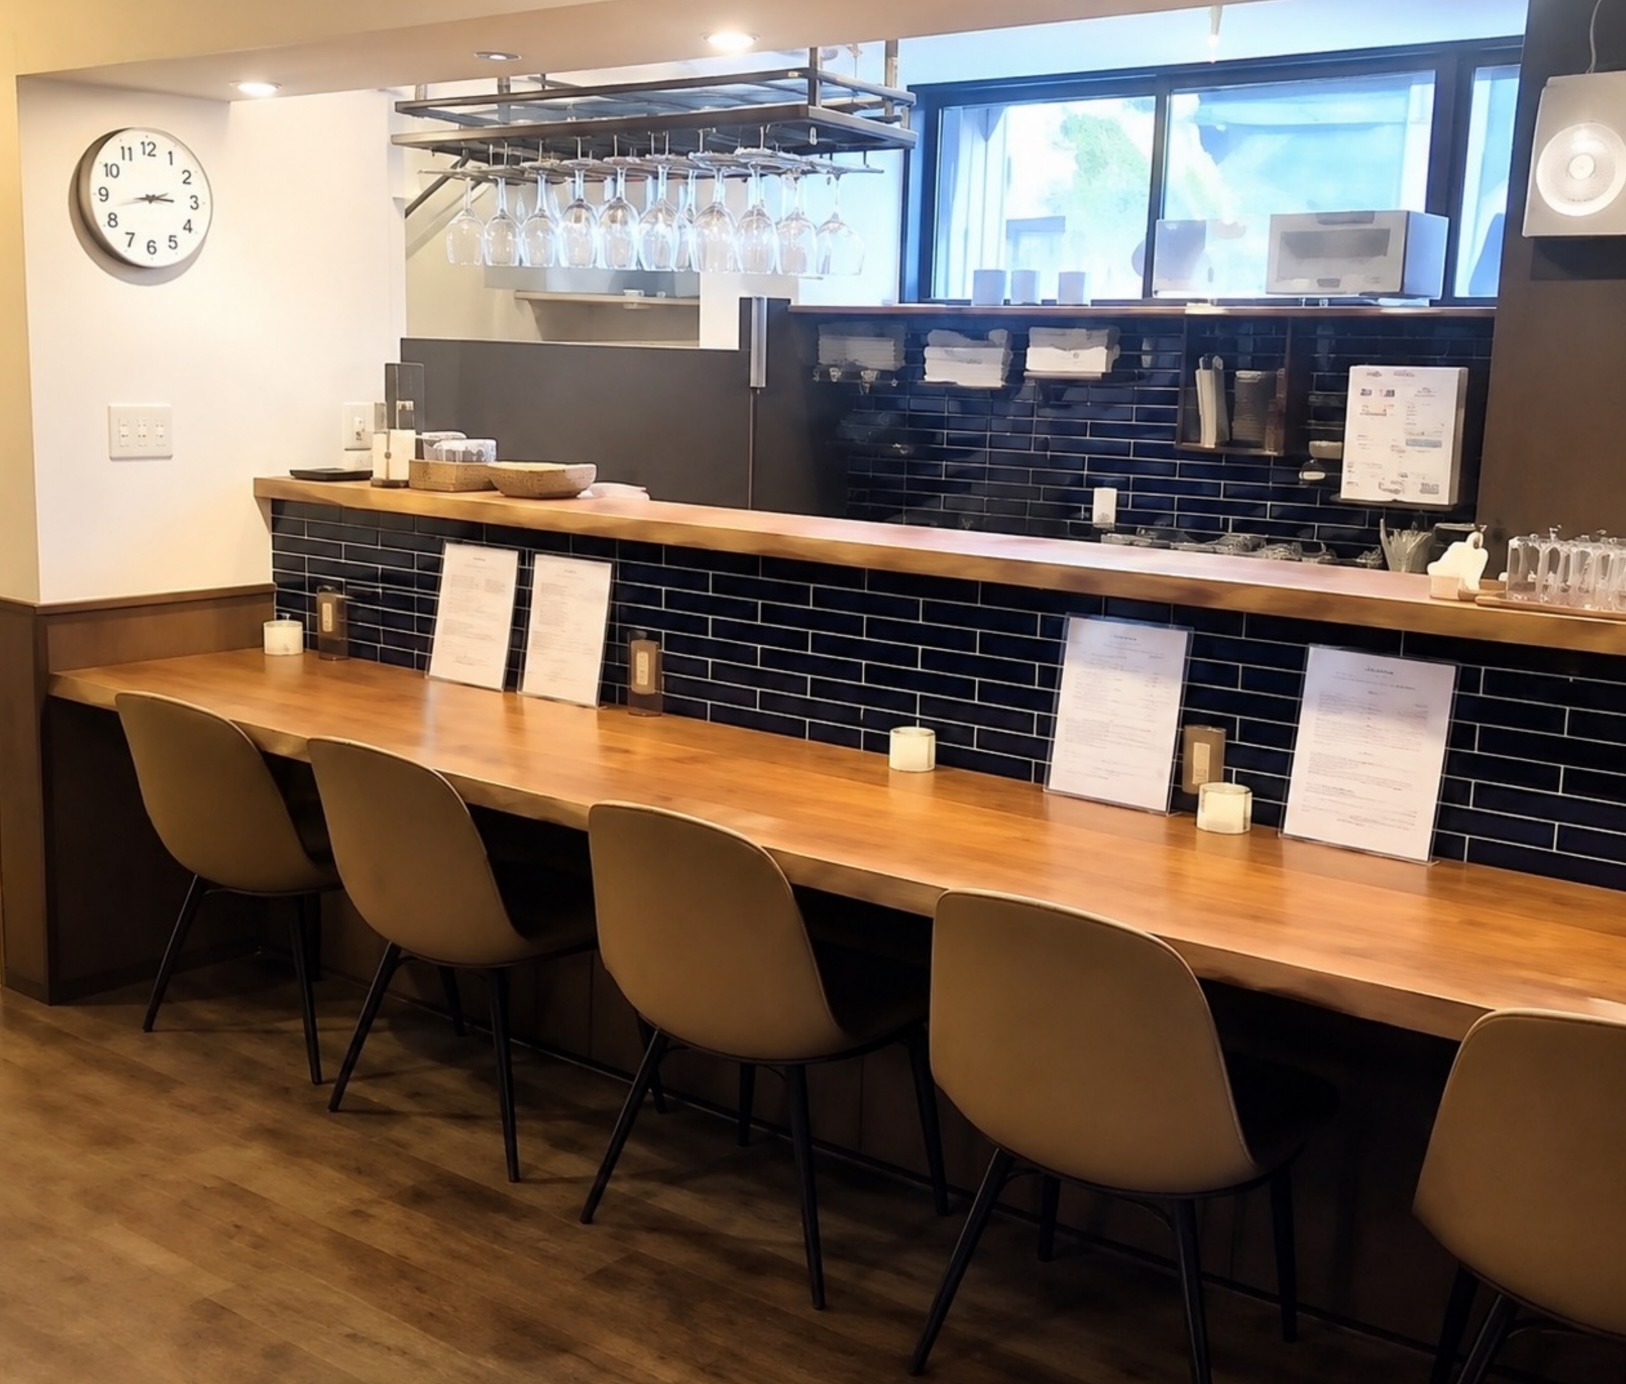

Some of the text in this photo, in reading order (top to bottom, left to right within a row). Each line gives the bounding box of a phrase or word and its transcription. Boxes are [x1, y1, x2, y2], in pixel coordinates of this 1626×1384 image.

[120, 145, 133, 161] 11
[140, 141, 157, 157] 12
[168, 150, 174, 166] 1
[104, 163, 120, 178] 10
[181, 169, 192, 185] 2
[98, 187, 109, 202] 9
[189, 195, 200, 210] 3
[107, 212, 118, 228] 8
[183, 219, 193, 233] 4
[125, 232, 135, 247] 7
[168, 235, 178, 250] 5
[147, 240, 157, 255] 6
